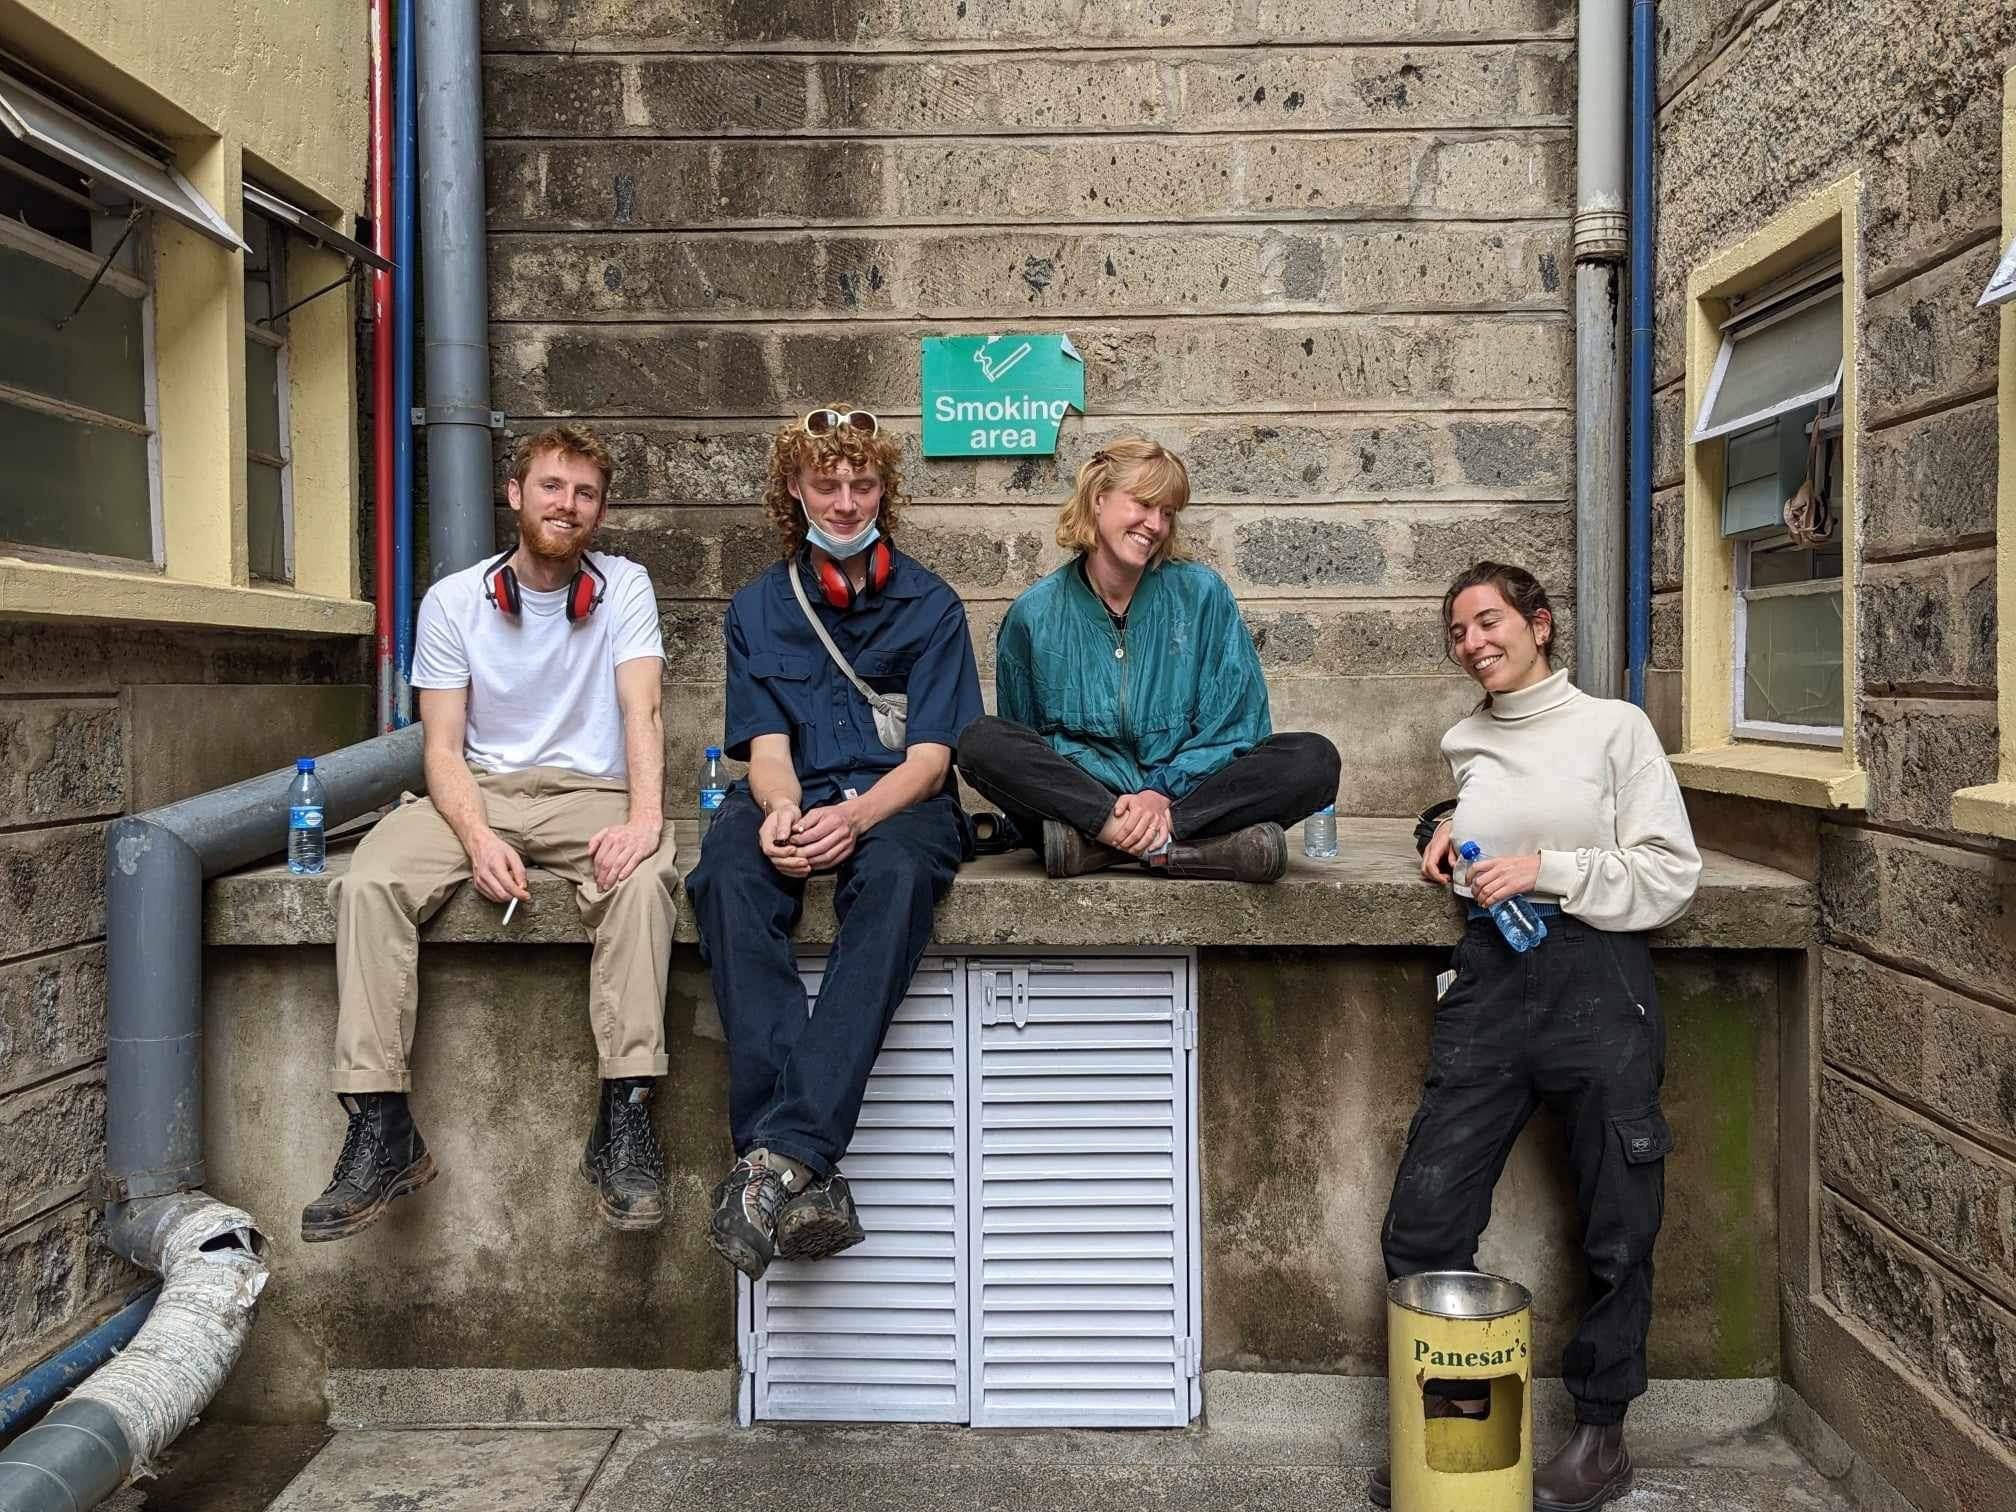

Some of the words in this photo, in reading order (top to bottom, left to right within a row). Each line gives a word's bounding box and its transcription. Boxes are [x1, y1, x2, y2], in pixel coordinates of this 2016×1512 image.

[935, 395, 1069, 427] Smoking
[970, 428, 1037, 449] area
[1414, 1338, 1527, 1367] Panesar's
